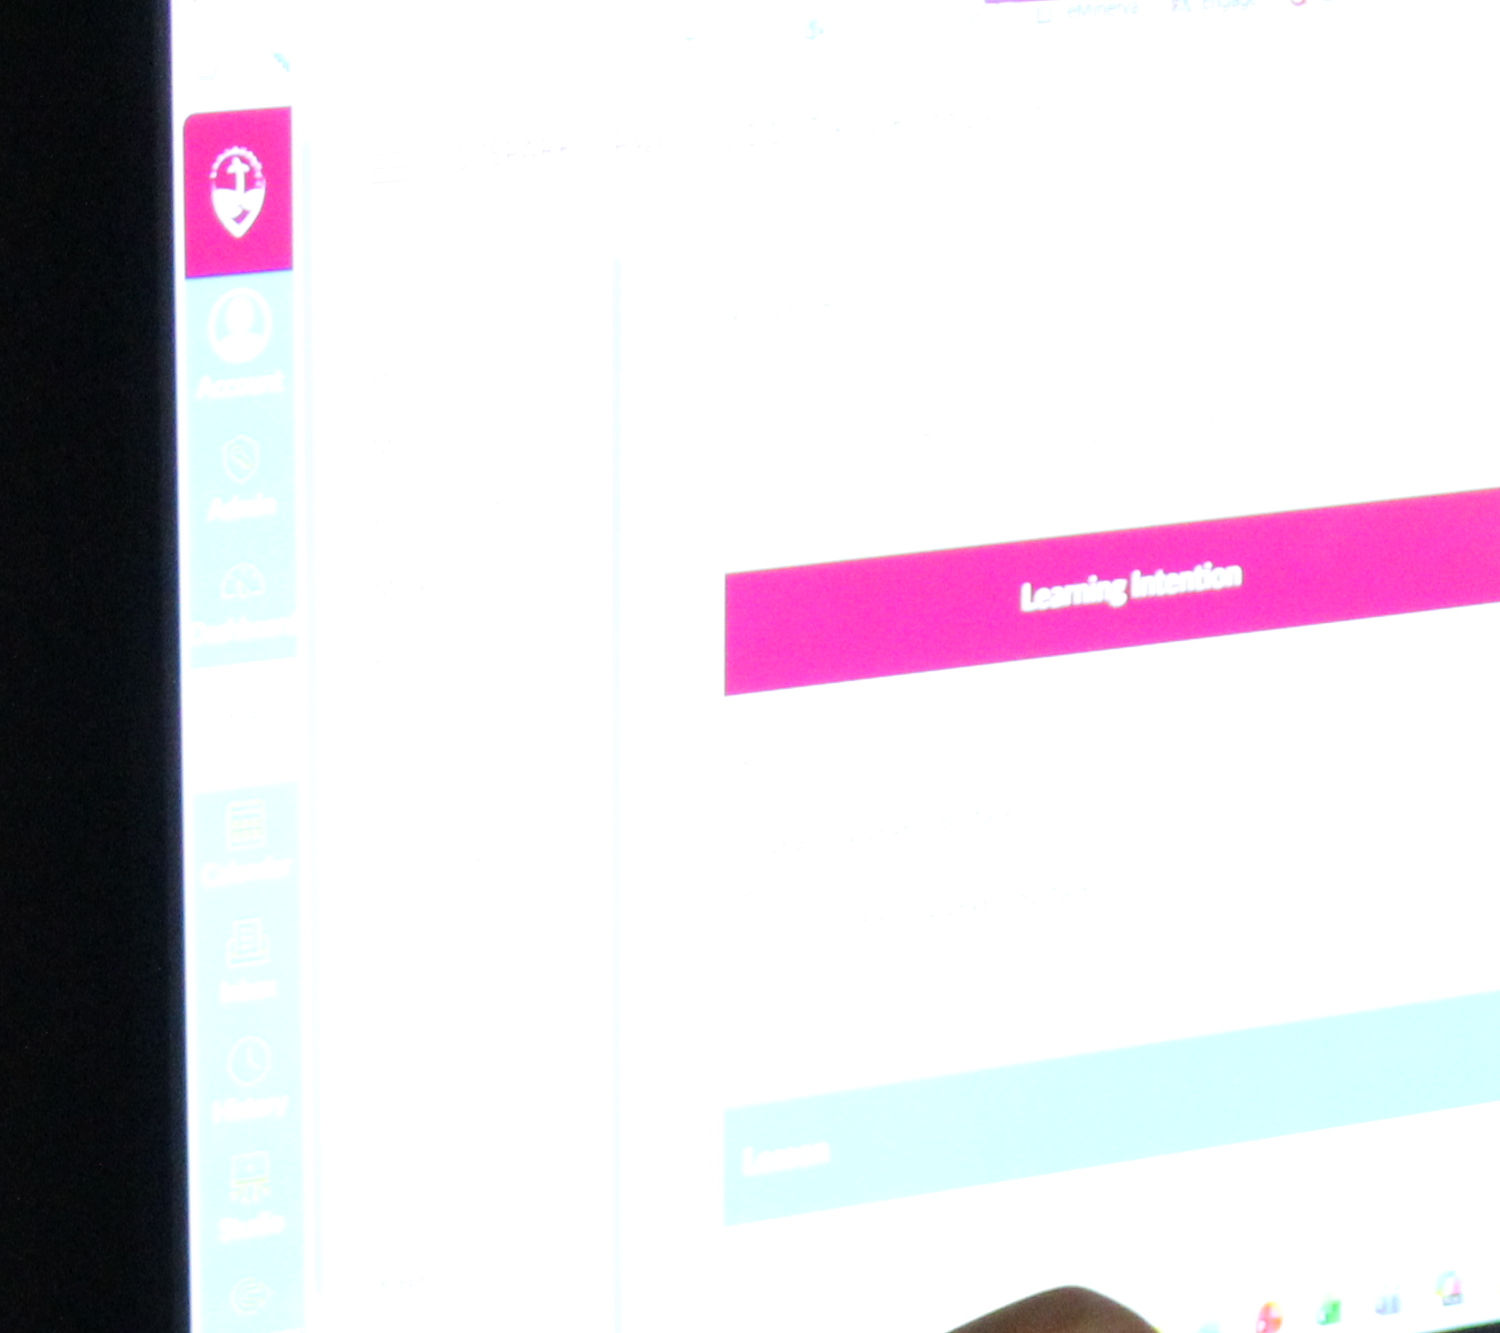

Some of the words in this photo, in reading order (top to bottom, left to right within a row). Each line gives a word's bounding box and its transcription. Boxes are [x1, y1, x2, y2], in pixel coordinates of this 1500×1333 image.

[197, 371, 285, 400] Account
[207, 494, 277, 521] Admin
[1020, 574, 1128, 612] Learning
[1130, 560, 1243, 598] Intention
[211, 1095, 289, 1124] History
